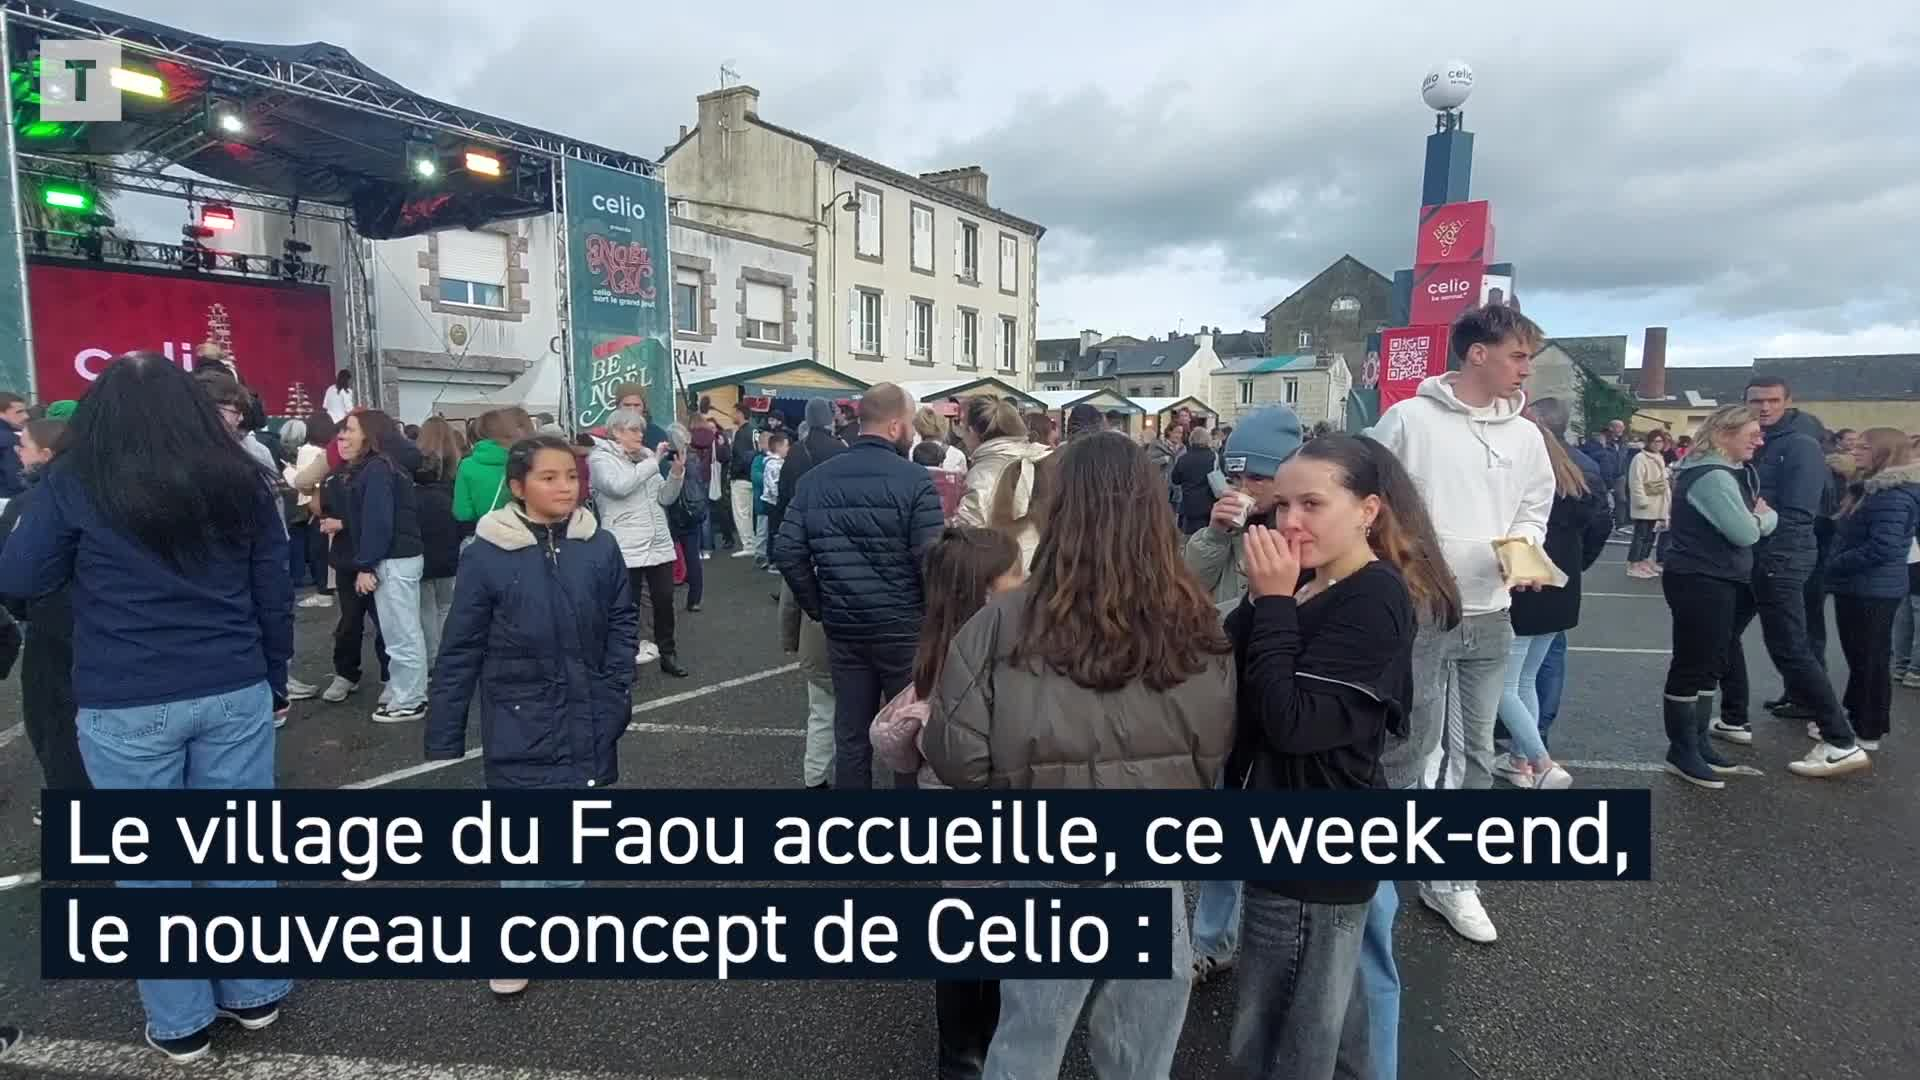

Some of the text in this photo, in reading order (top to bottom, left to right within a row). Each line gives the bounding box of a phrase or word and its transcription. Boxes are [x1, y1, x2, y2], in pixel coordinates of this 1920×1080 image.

[592, 195, 645, 220] celio
[1428, 279, 1470, 294] celio
[592, 354, 622, 382] BE
